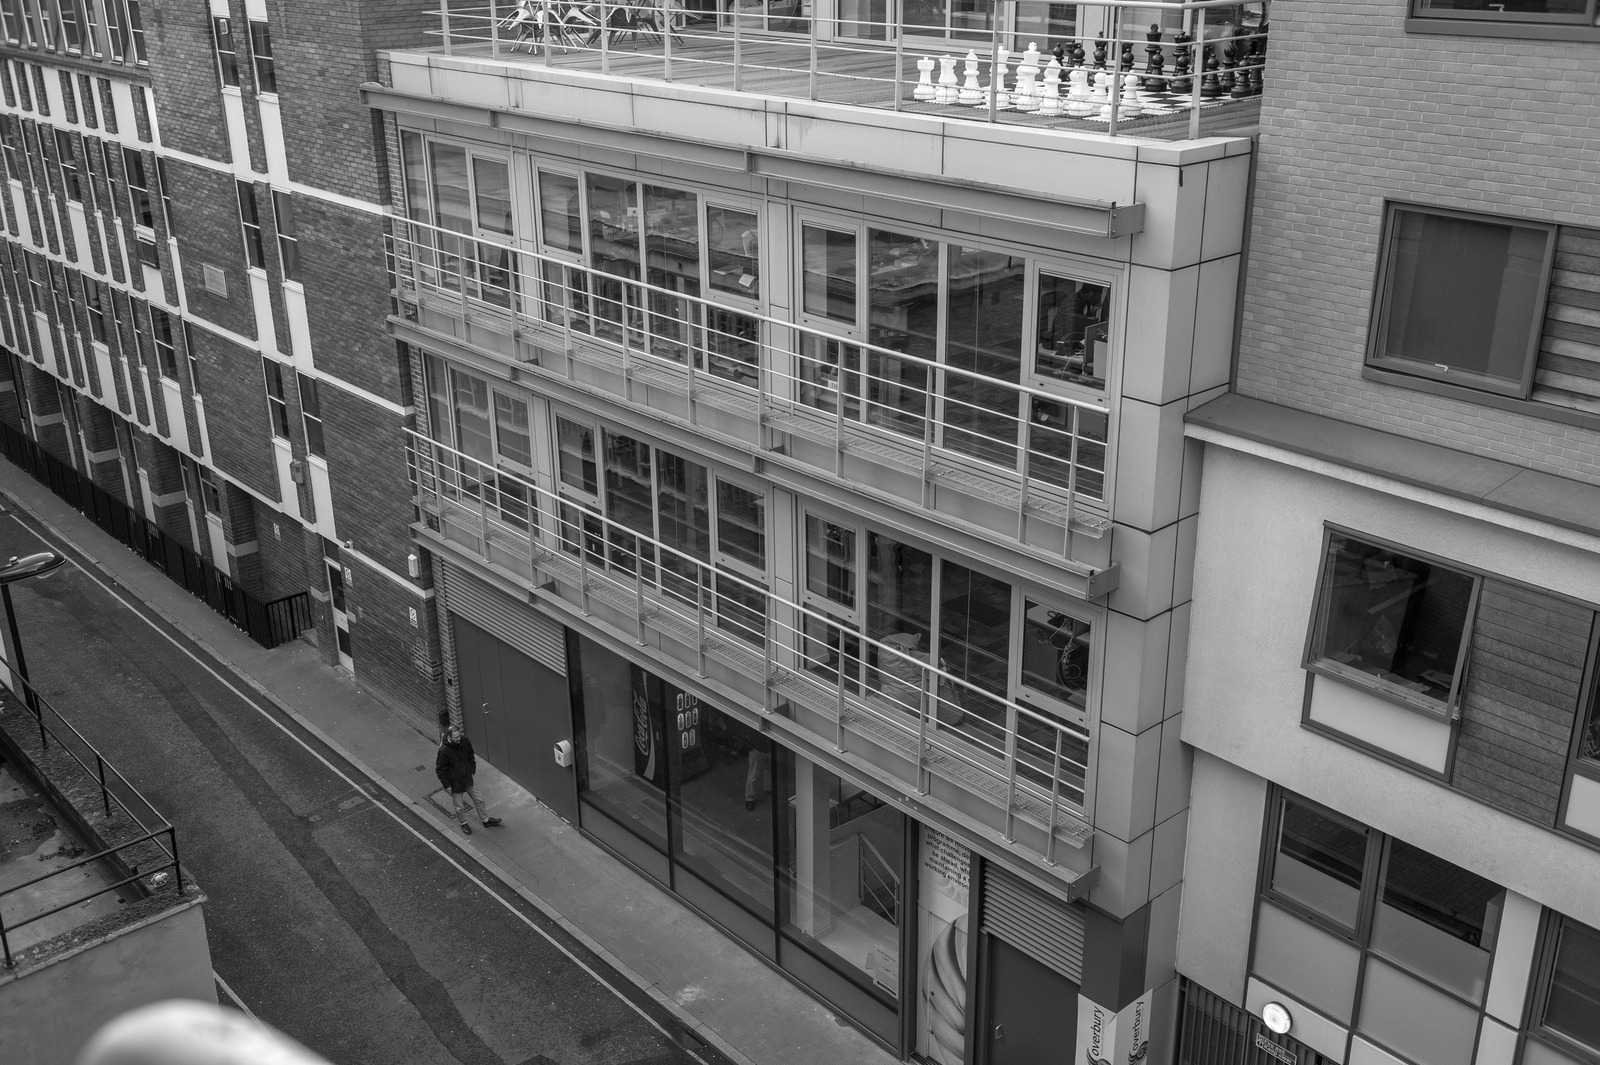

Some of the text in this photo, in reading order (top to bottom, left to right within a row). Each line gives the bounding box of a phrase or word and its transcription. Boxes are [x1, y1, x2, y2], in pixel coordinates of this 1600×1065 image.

[926, 840, 940, 851] what
[932, 850, 940, 858] be
[924, 861, 947, 879] working
[929, 857, 961, 879] maintaining
[1090, 1005, 1105, 1057] overbury
[1132, 1001, 1144, 1051] overbury
